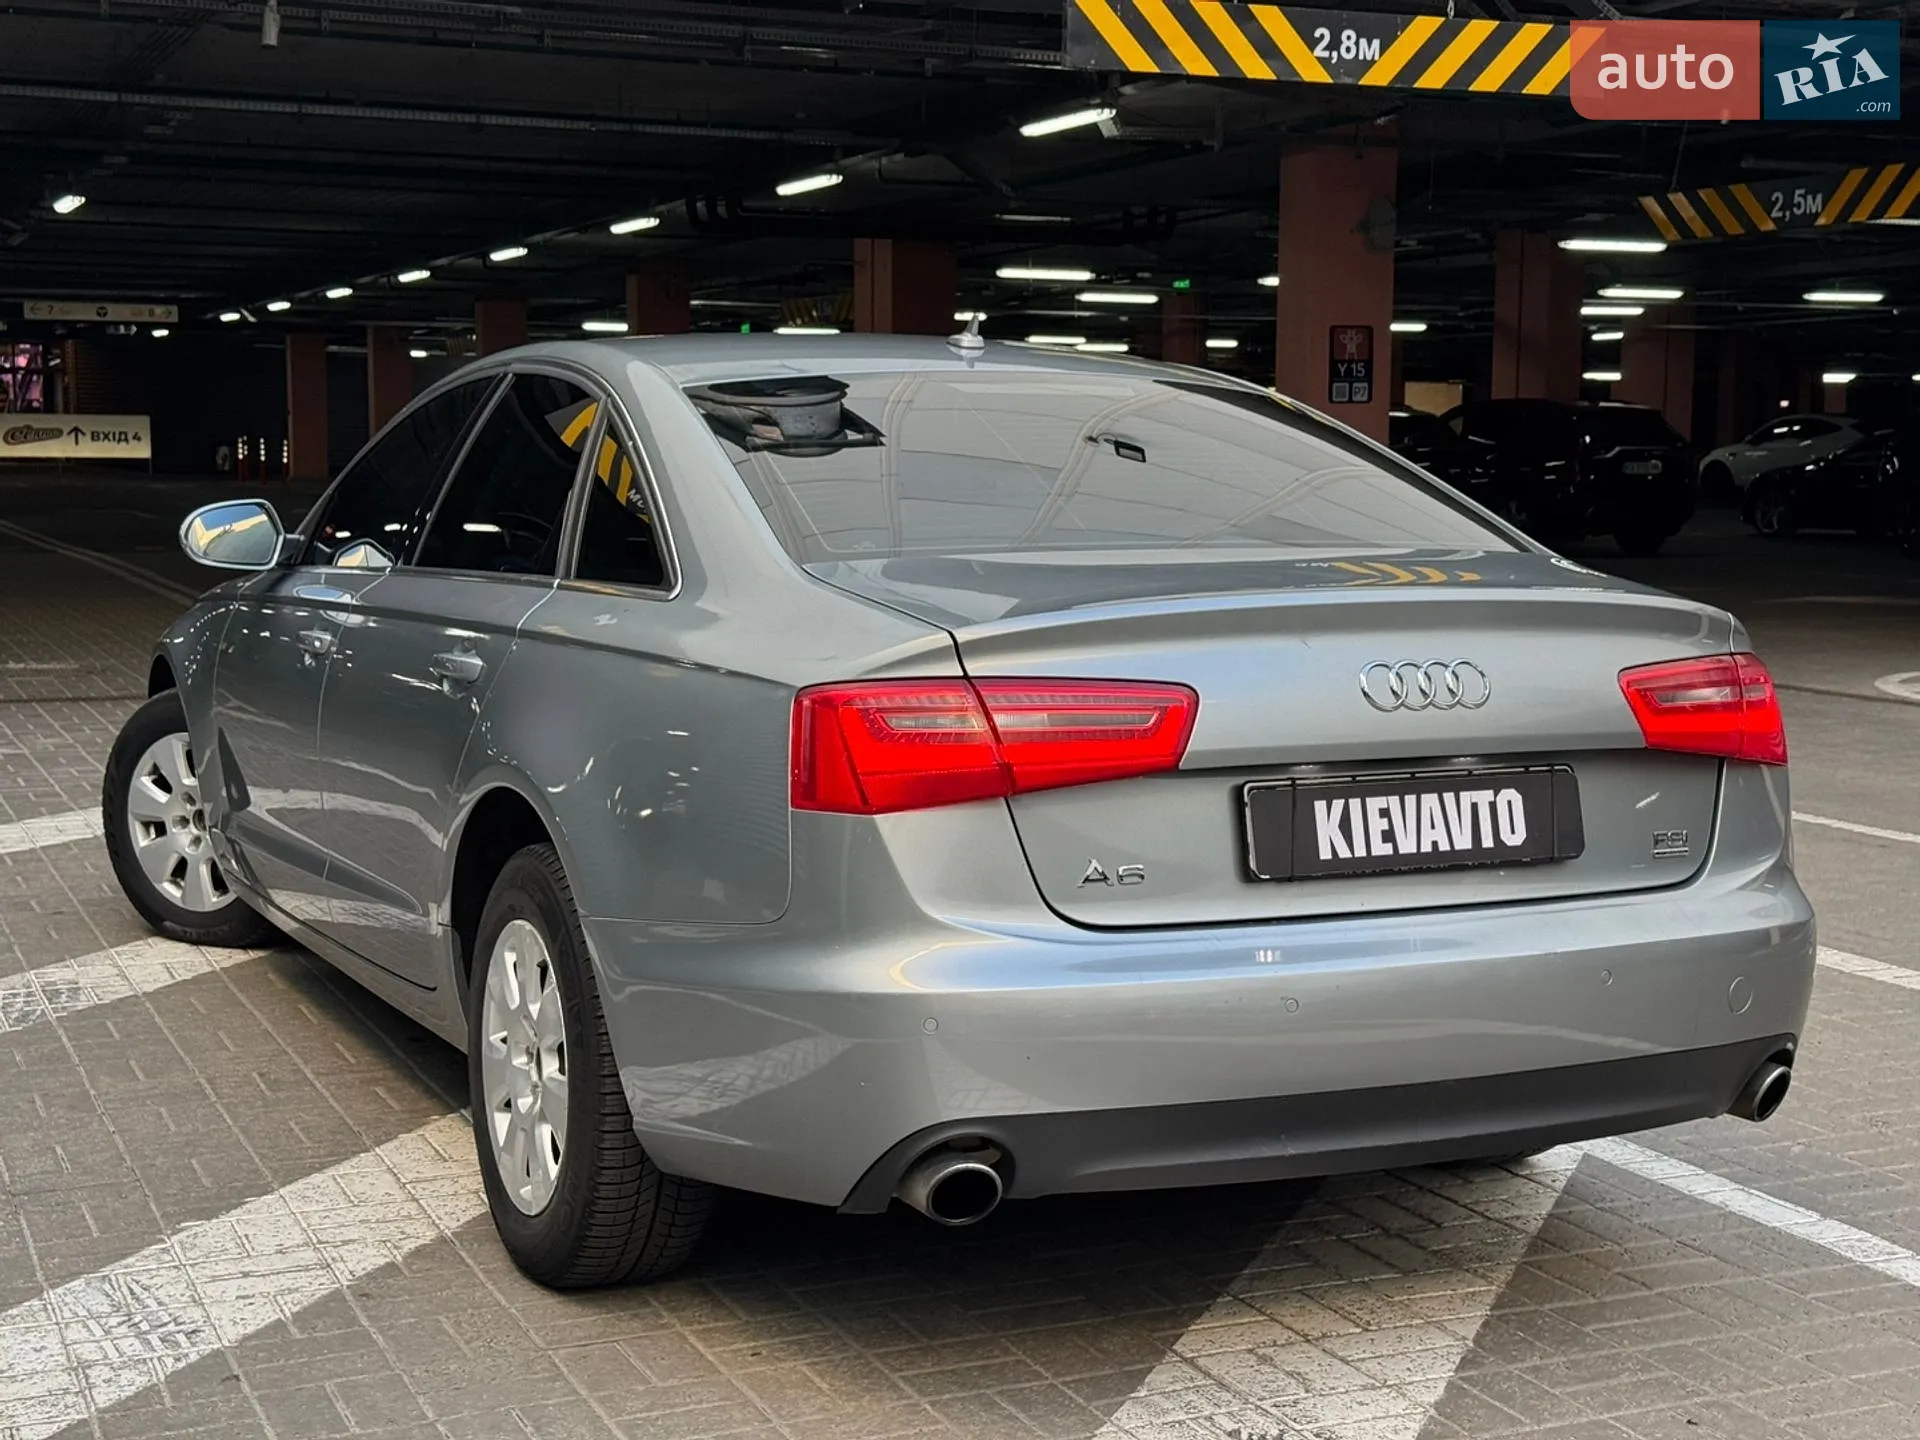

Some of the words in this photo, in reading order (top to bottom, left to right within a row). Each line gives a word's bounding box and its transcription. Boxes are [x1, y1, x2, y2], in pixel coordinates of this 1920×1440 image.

[1338, 362, 1348, 376] Y
[1351, 362, 1366, 376] 15
[91, 430, 130, 445] ВХІД
[132, 431, 143, 442] 4
[1314, 788, 1527, 860] KIEVAVTO
[1077, 858, 1145, 888] A6
